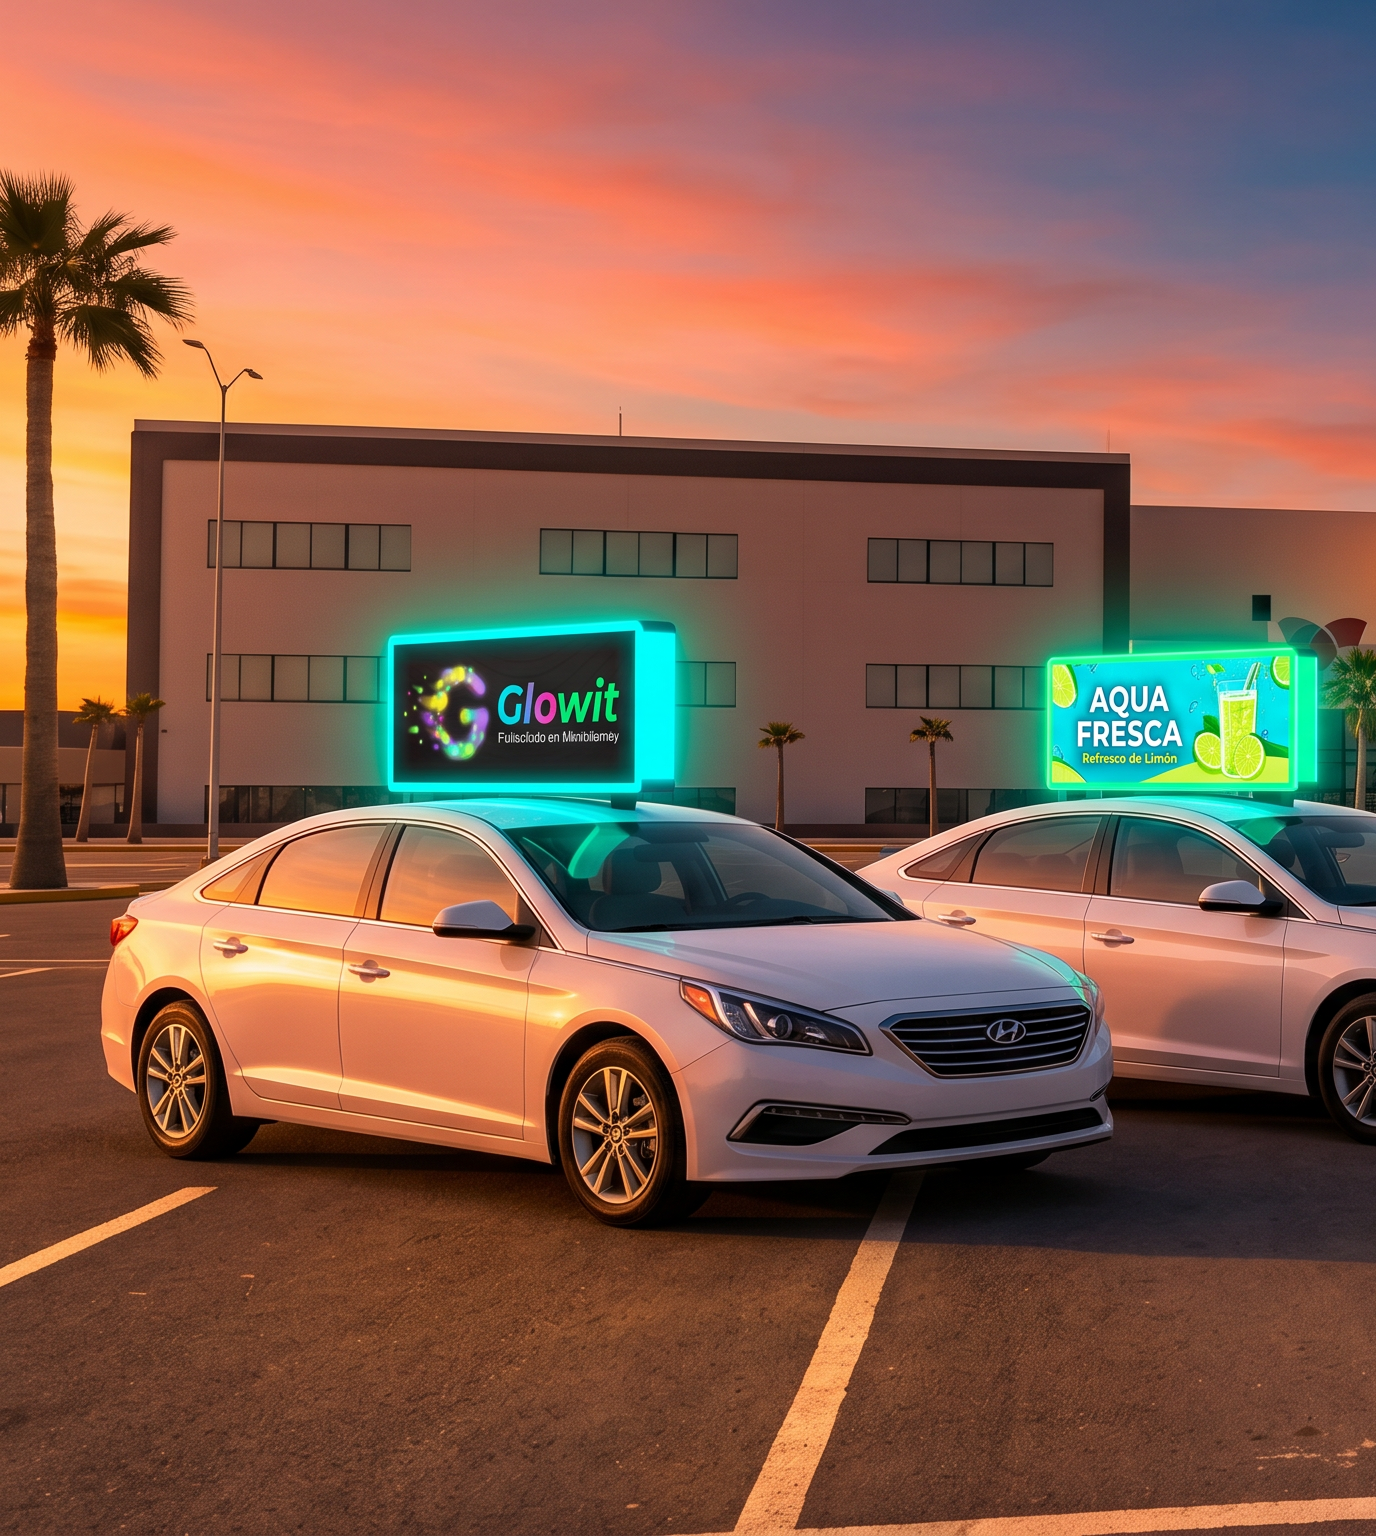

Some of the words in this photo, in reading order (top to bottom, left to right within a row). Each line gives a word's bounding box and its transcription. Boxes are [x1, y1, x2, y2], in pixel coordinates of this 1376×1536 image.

[498, 677, 620, 725] Glowit
[1089, 685, 1169, 719] AQUA
[547, 733, 560, 744] en
[1077, 719, 1183, 748] FRESCA
[1082, 752, 1127, 764] Refresco
[1128, 752, 1142, 764] de
[1146, 752, 1178, 765] Limón
